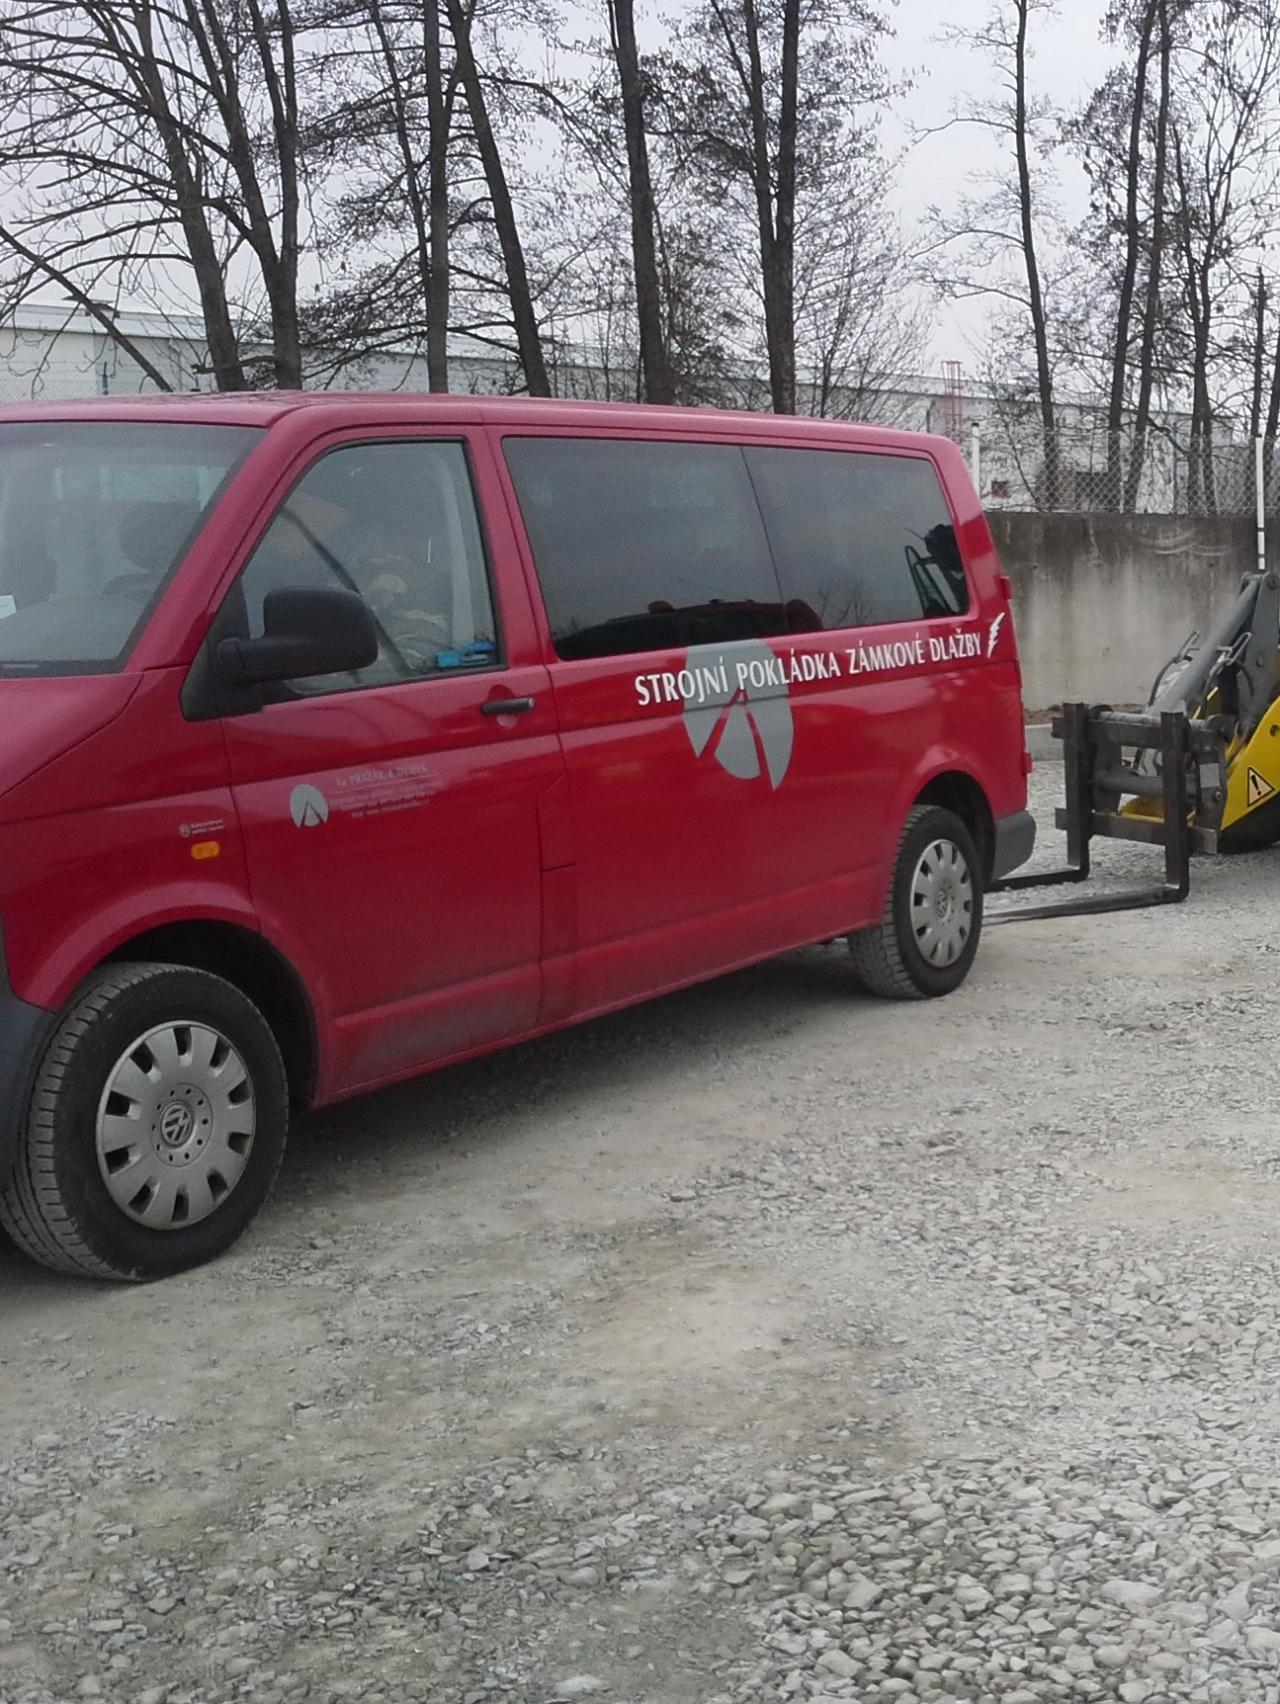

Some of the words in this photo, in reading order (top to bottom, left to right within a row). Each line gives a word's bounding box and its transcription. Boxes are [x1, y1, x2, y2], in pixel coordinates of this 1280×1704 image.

[635, 656, 729, 706] STROJNÍ
[736, 648, 842, 690] POKLÁDKA
[846, 633, 926, 675] ZÁMKOVÉ
[929, 627, 982, 662] DLAŽBY
